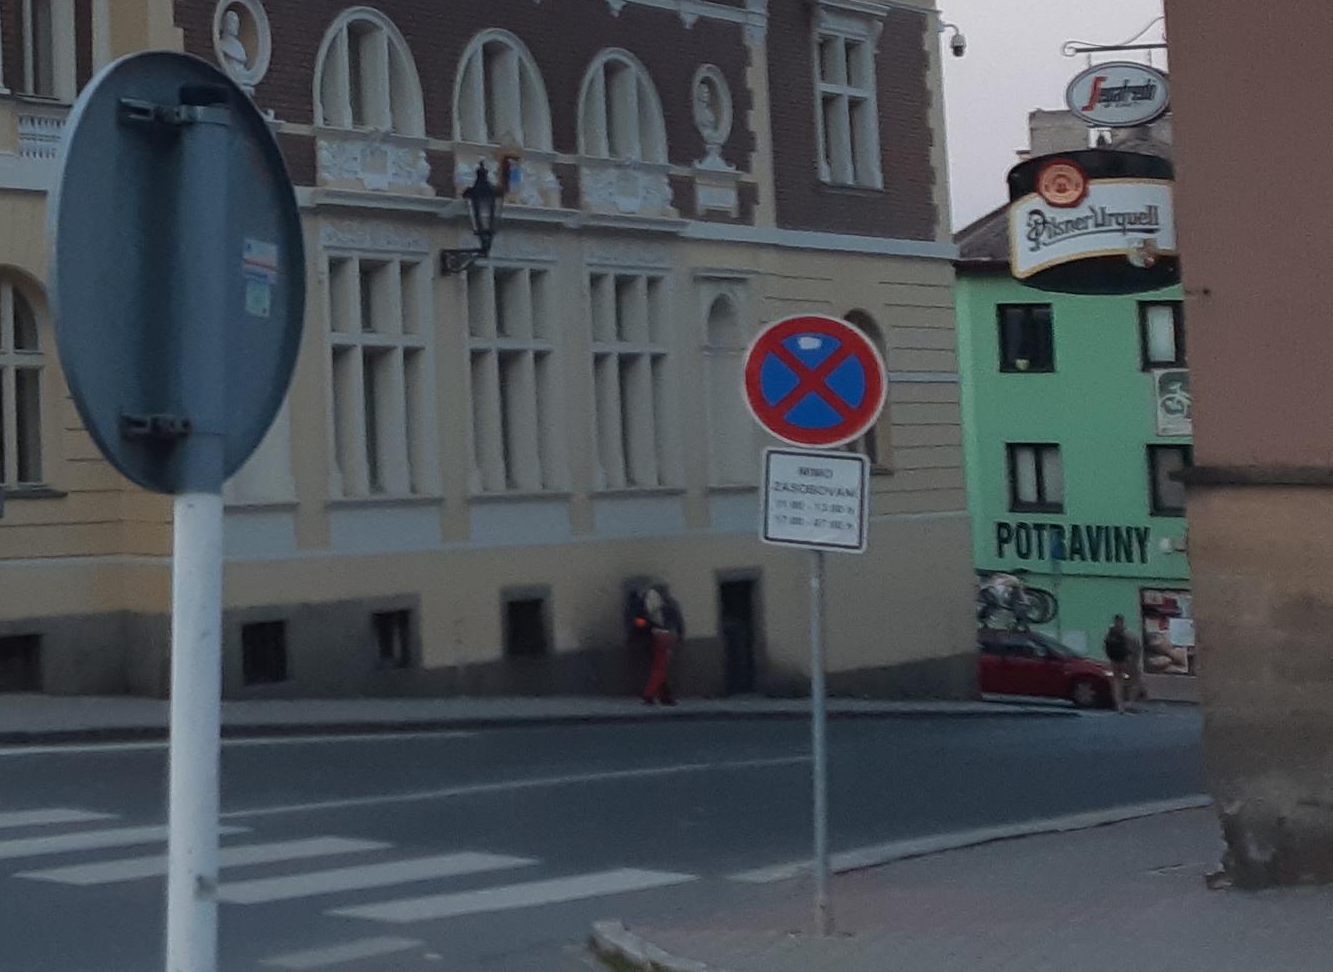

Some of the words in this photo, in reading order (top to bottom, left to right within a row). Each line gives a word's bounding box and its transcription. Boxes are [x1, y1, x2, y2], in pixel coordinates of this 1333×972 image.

[1027, 208, 1093, 252] Pilsner
[1089, 205, 1160, 233] Urquell
[995, 521, 1152, 564] POTRAVINY
